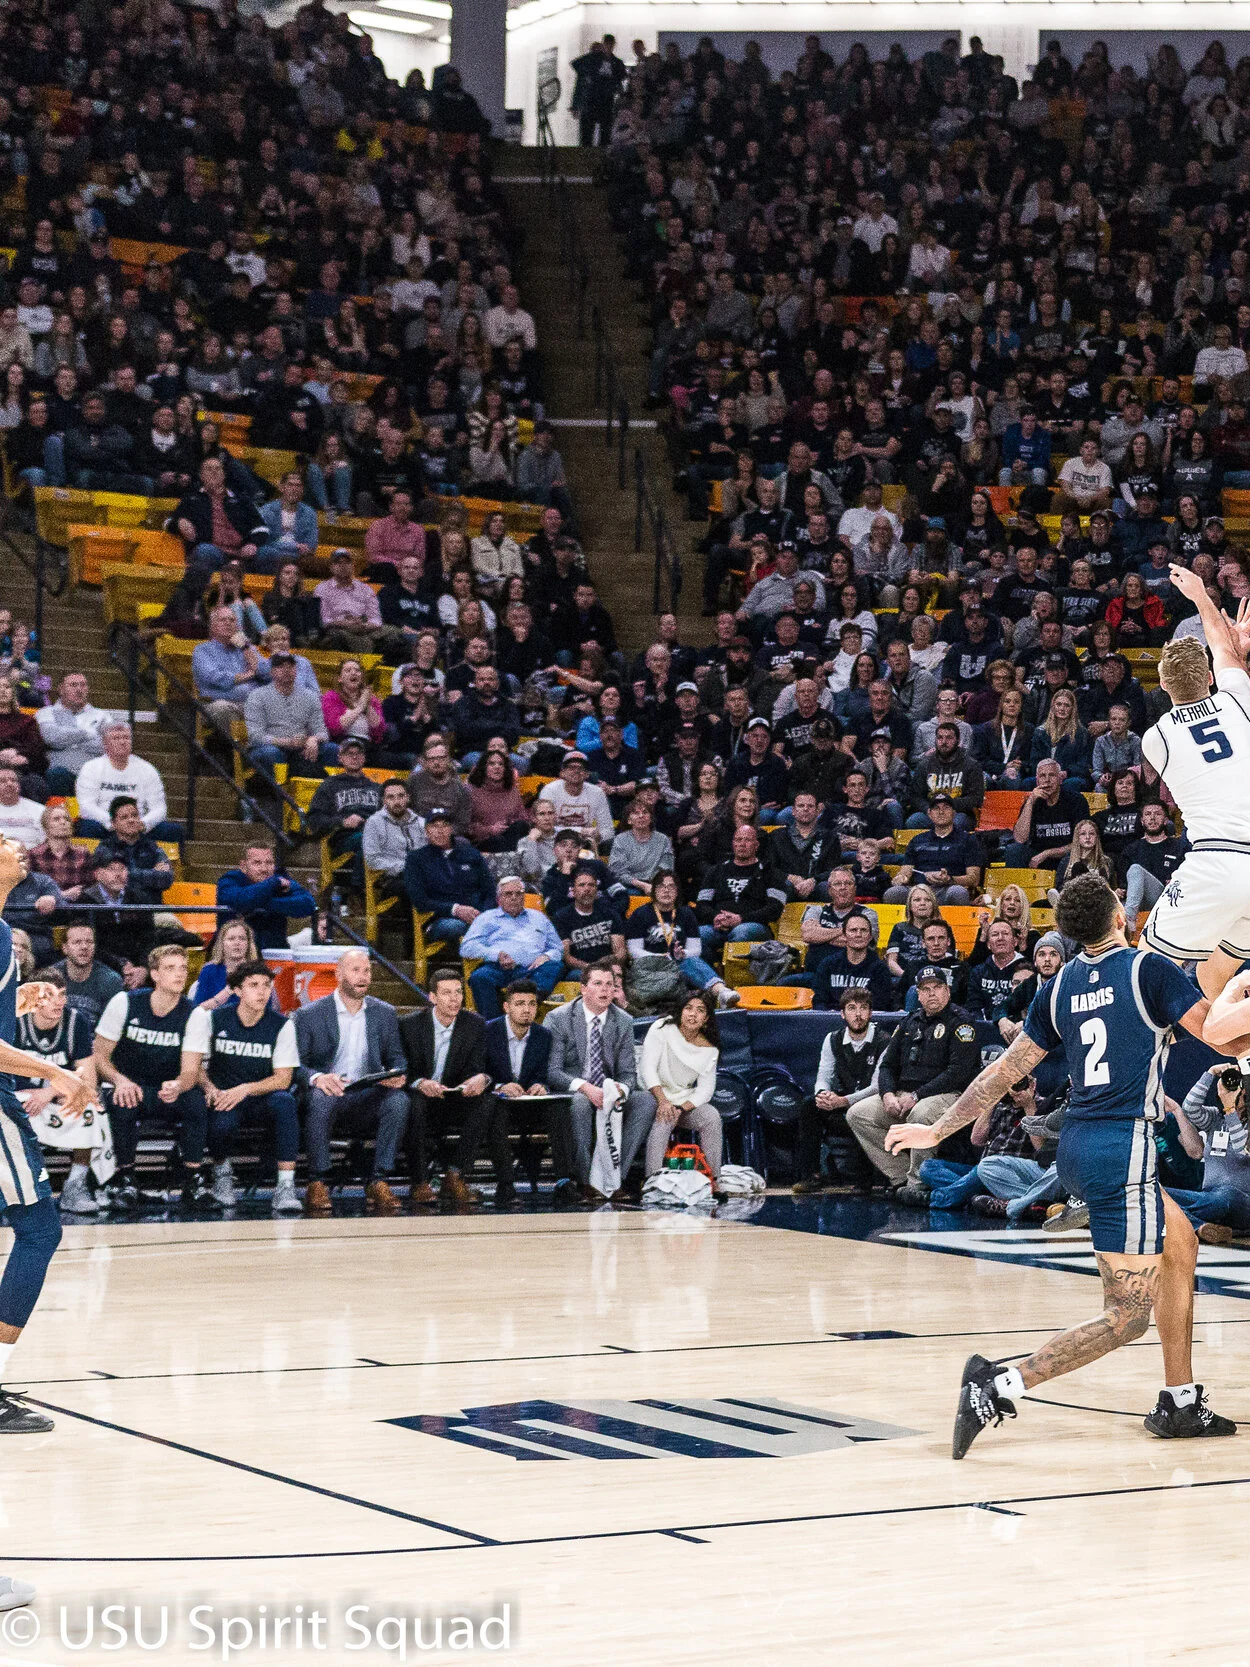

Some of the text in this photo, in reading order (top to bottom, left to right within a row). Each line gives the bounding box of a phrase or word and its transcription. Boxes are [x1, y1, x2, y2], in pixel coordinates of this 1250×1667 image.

[1170, 697, 1222, 725] MERRILL
[1188, 718, 1233, 763] 5
[127, 1025, 180, 1047] NEVADA
[215, 1038, 272, 1059] NEVADA
[1079, 1017, 1110, 1087] 2
